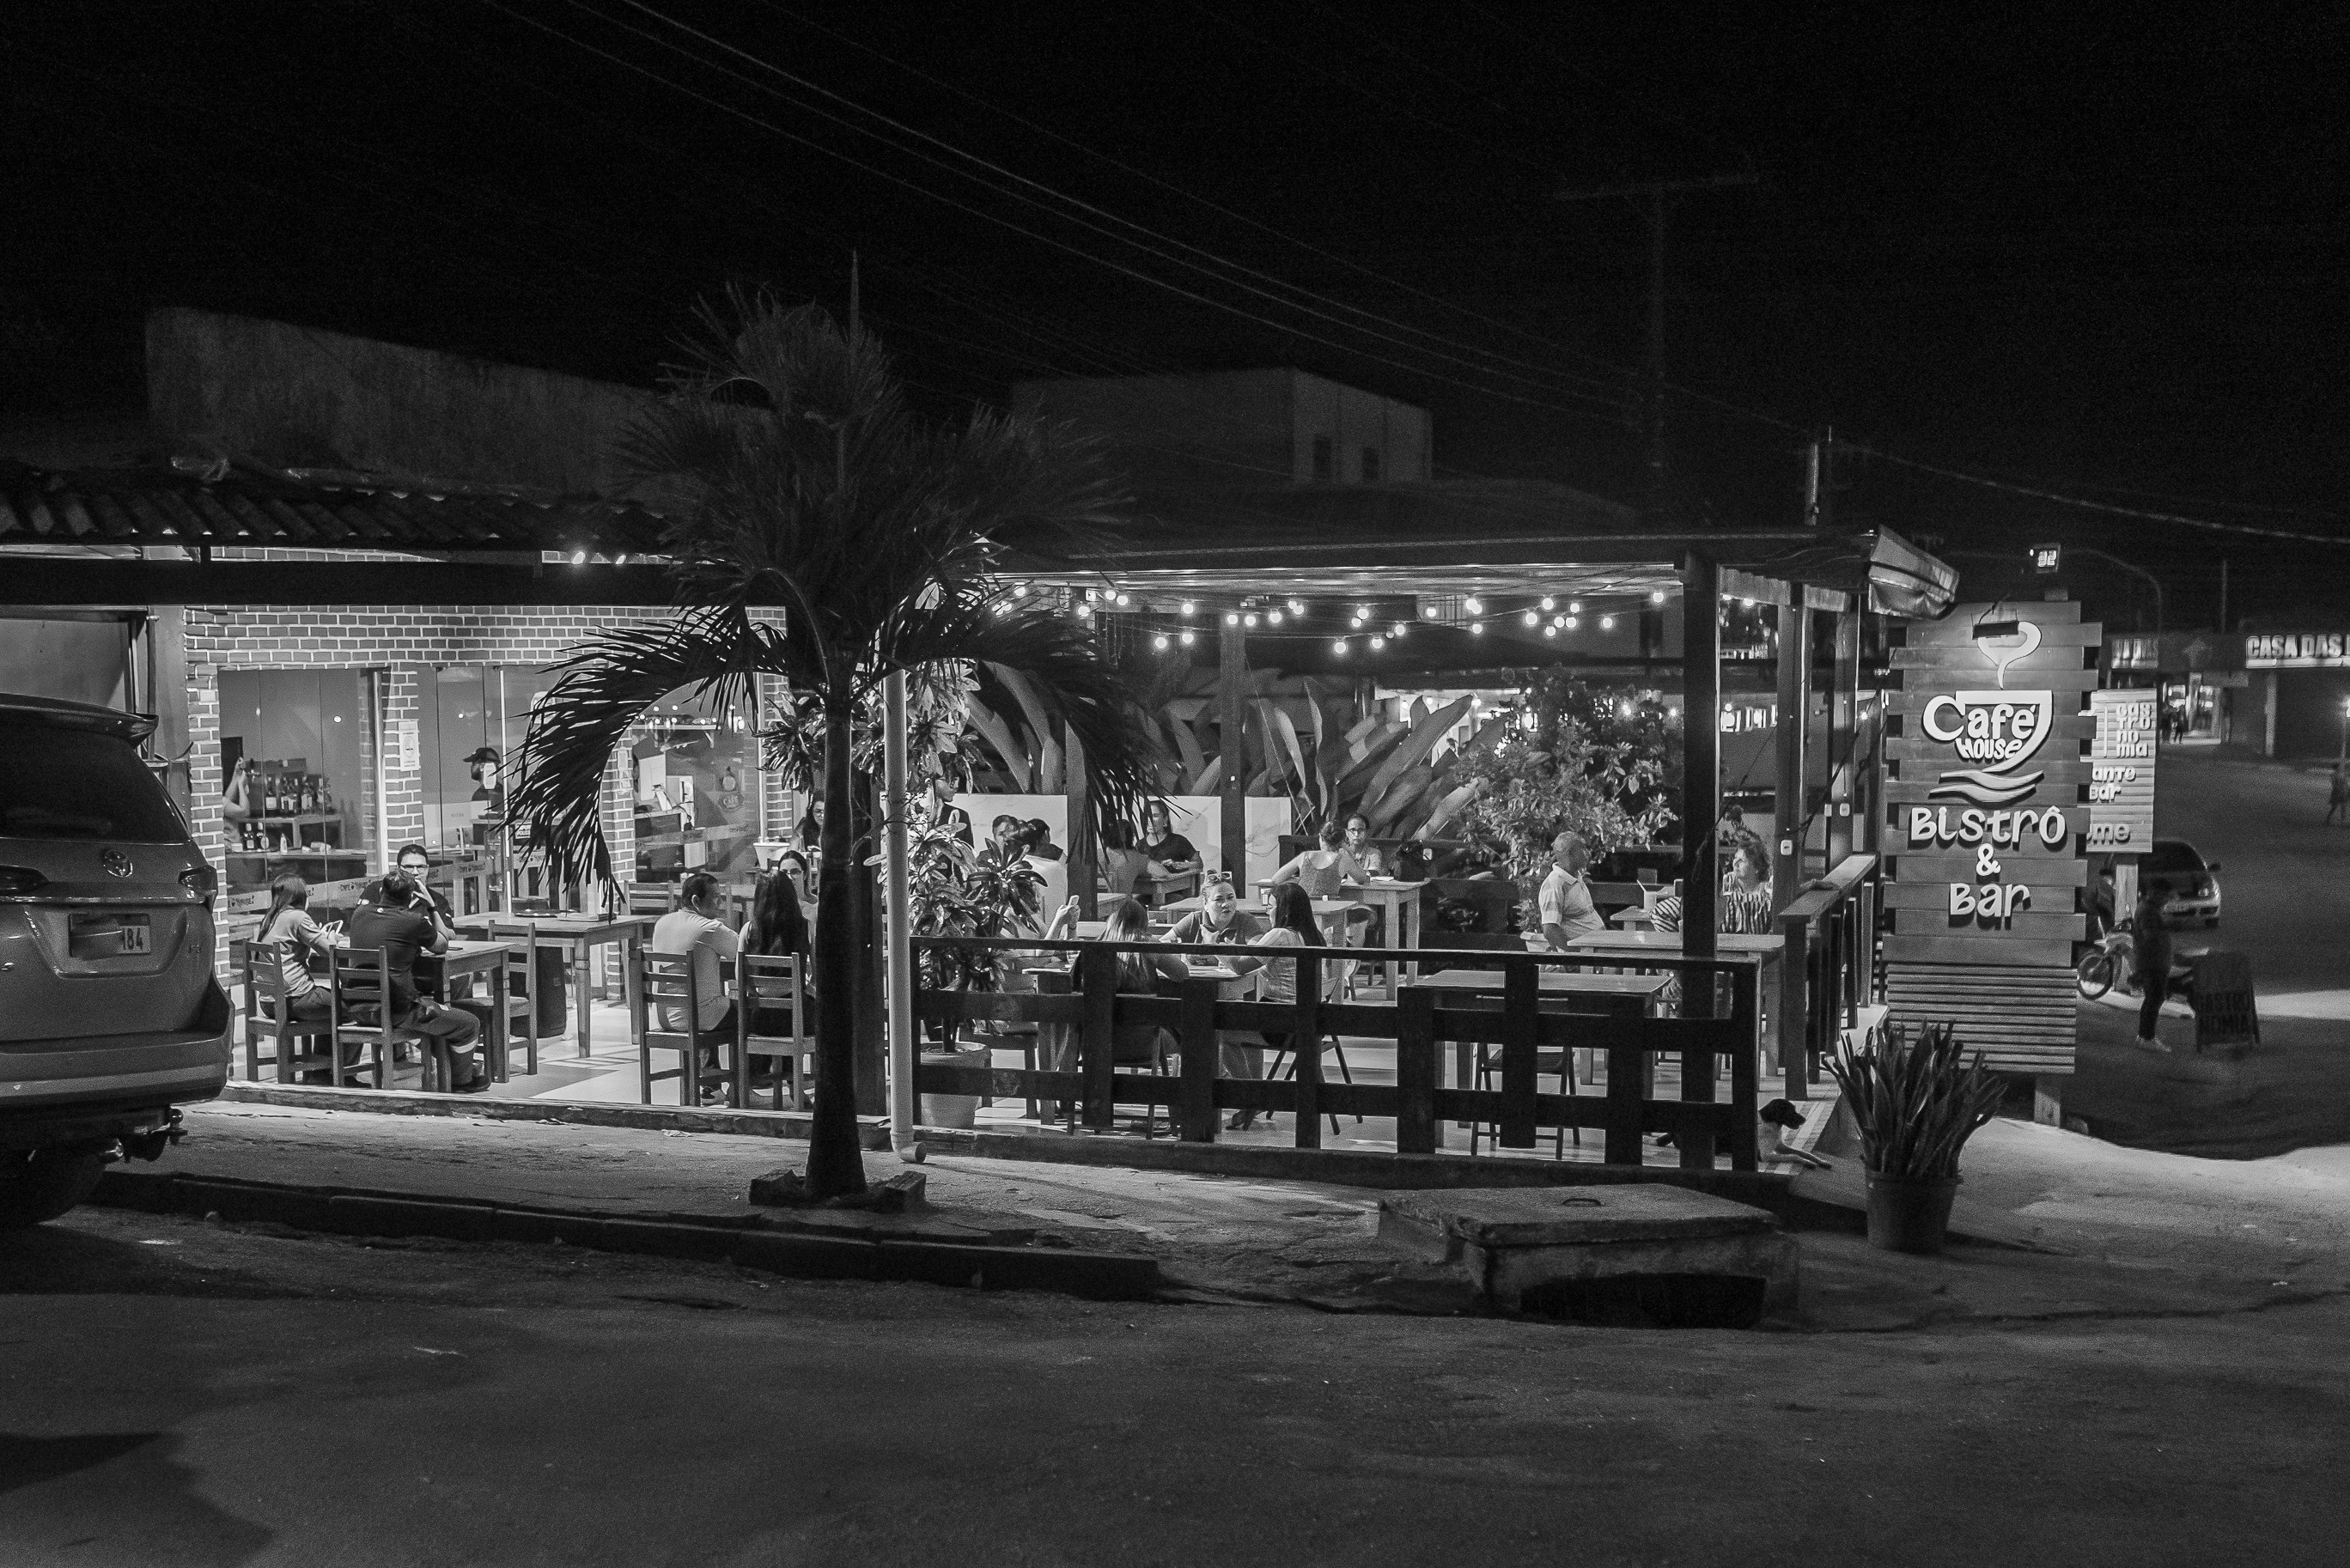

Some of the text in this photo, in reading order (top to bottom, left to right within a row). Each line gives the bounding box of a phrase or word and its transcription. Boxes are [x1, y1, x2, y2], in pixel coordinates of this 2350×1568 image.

[2247, 635, 2298, 659] CASA
[2301, 633, 2342, 658] DAS
[1922, 695, 2036, 740] Café
[1911, 805, 2065, 843] Bistrô
[1976, 843, 2000, 876] &
[1951, 883, 2030, 917] Bar
